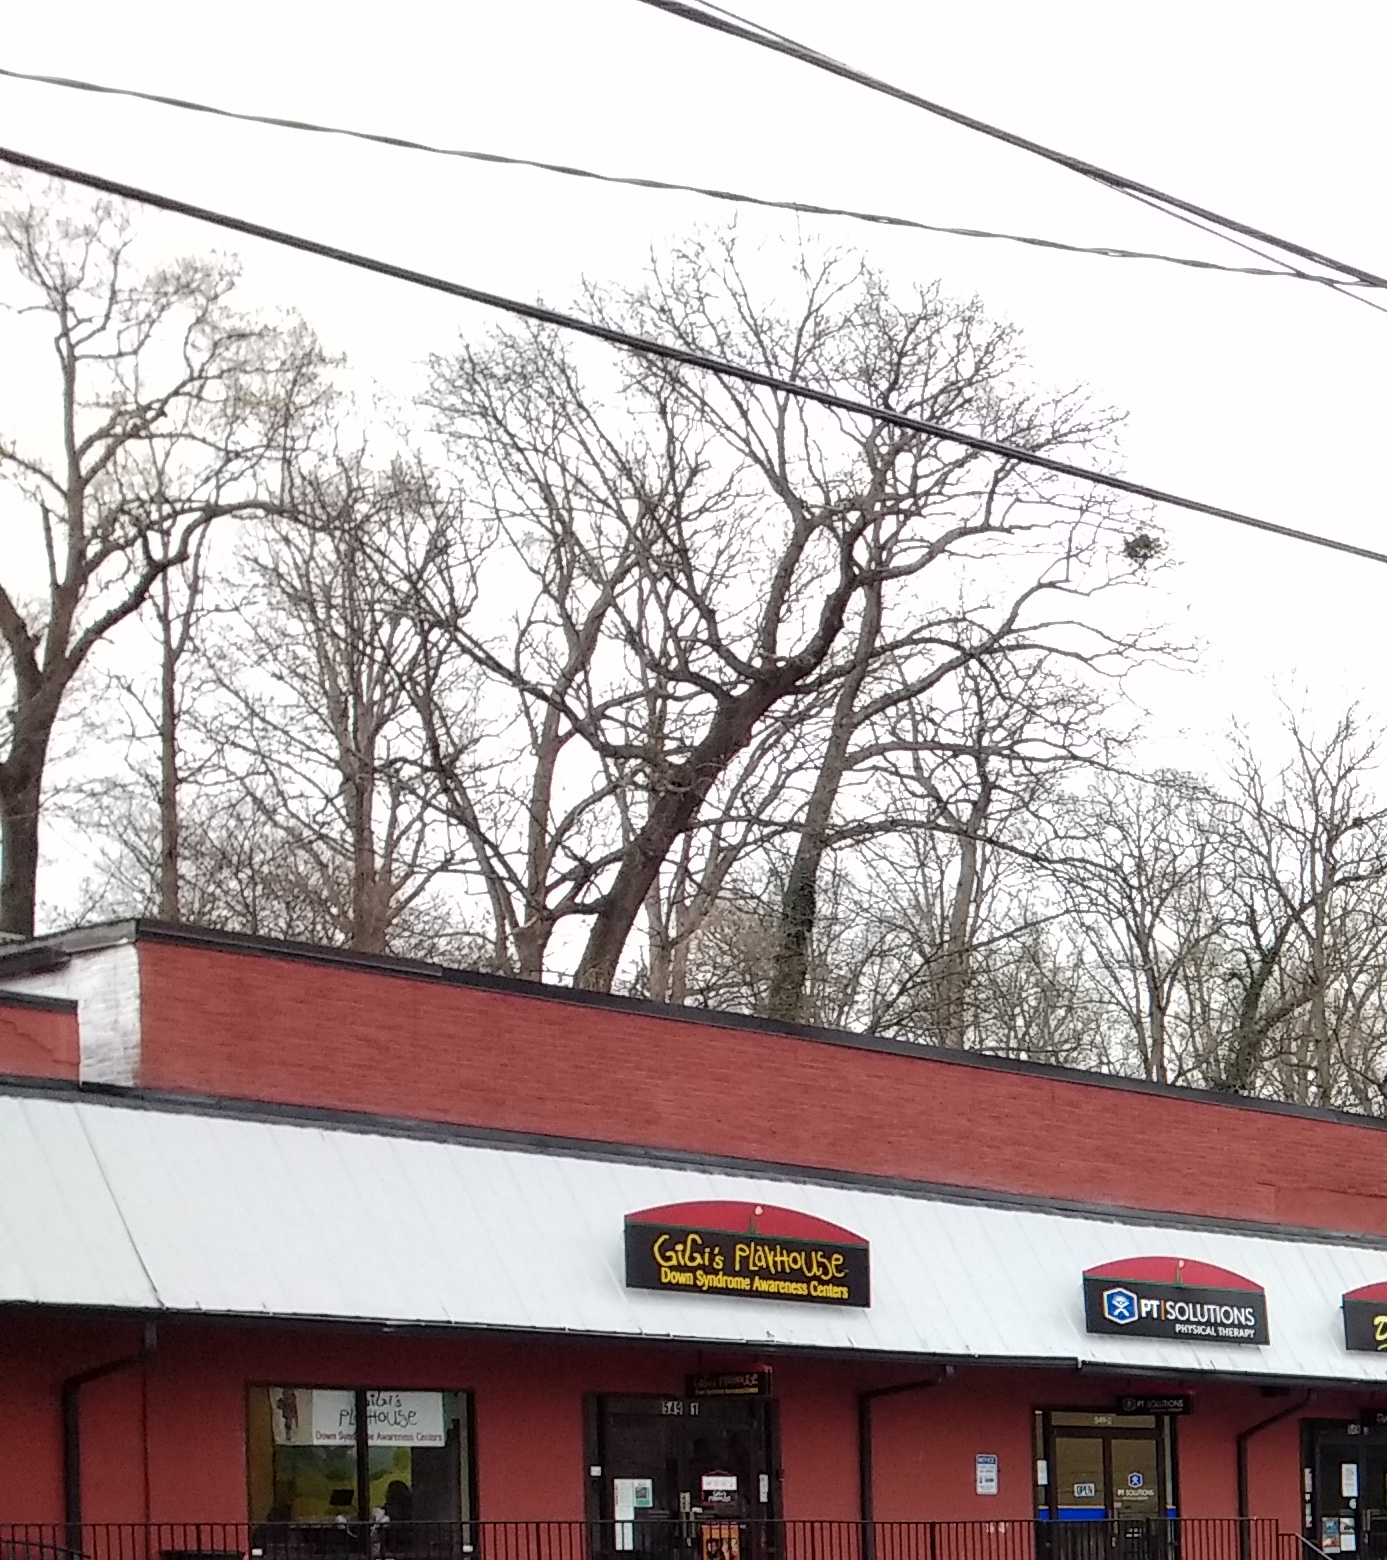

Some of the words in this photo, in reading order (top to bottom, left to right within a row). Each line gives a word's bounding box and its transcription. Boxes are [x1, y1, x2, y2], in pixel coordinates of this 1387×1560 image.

[661, 1267, 693, 1285] Down
[696, 1270, 750, 1290] Syndrome
[752, 1276, 808, 1295] Awareness
[810, 1281, 849, 1299] Centers
[1166, 1301, 1255, 1326] SOLUTIONS
[1175, 1323, 1216, 1336] PHYSICAL
[1217, 1326, 1255, 1339] THERAPY
